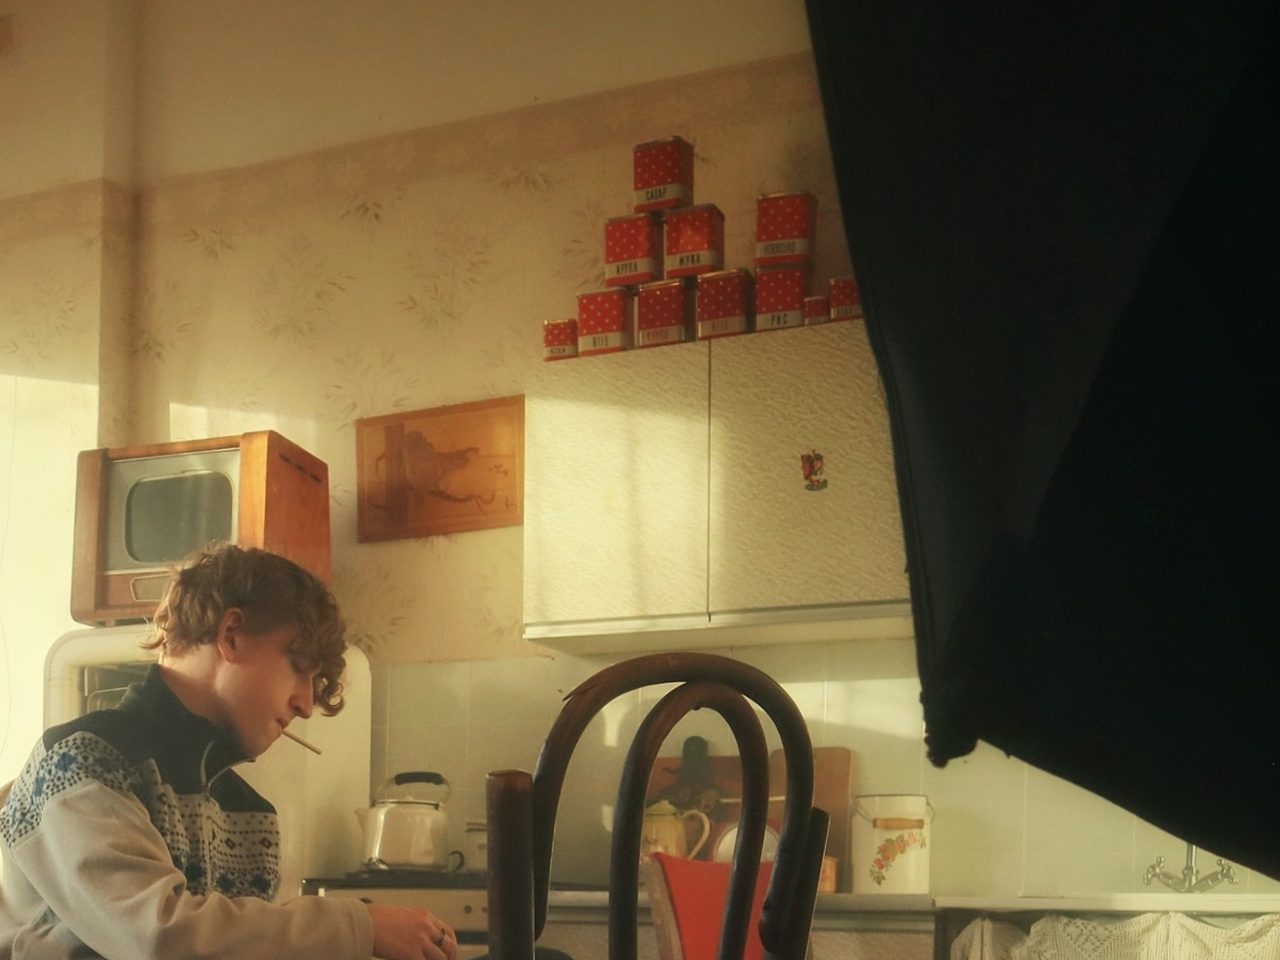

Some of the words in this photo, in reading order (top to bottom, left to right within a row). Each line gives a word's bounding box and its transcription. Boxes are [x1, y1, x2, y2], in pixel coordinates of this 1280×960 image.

[645, 187, 667, 201] САХАР
[679, 253, 700, 267] МУКА
[616, 262, 638, 275] КРУПА
[771, 313, 788, 326] РИС
